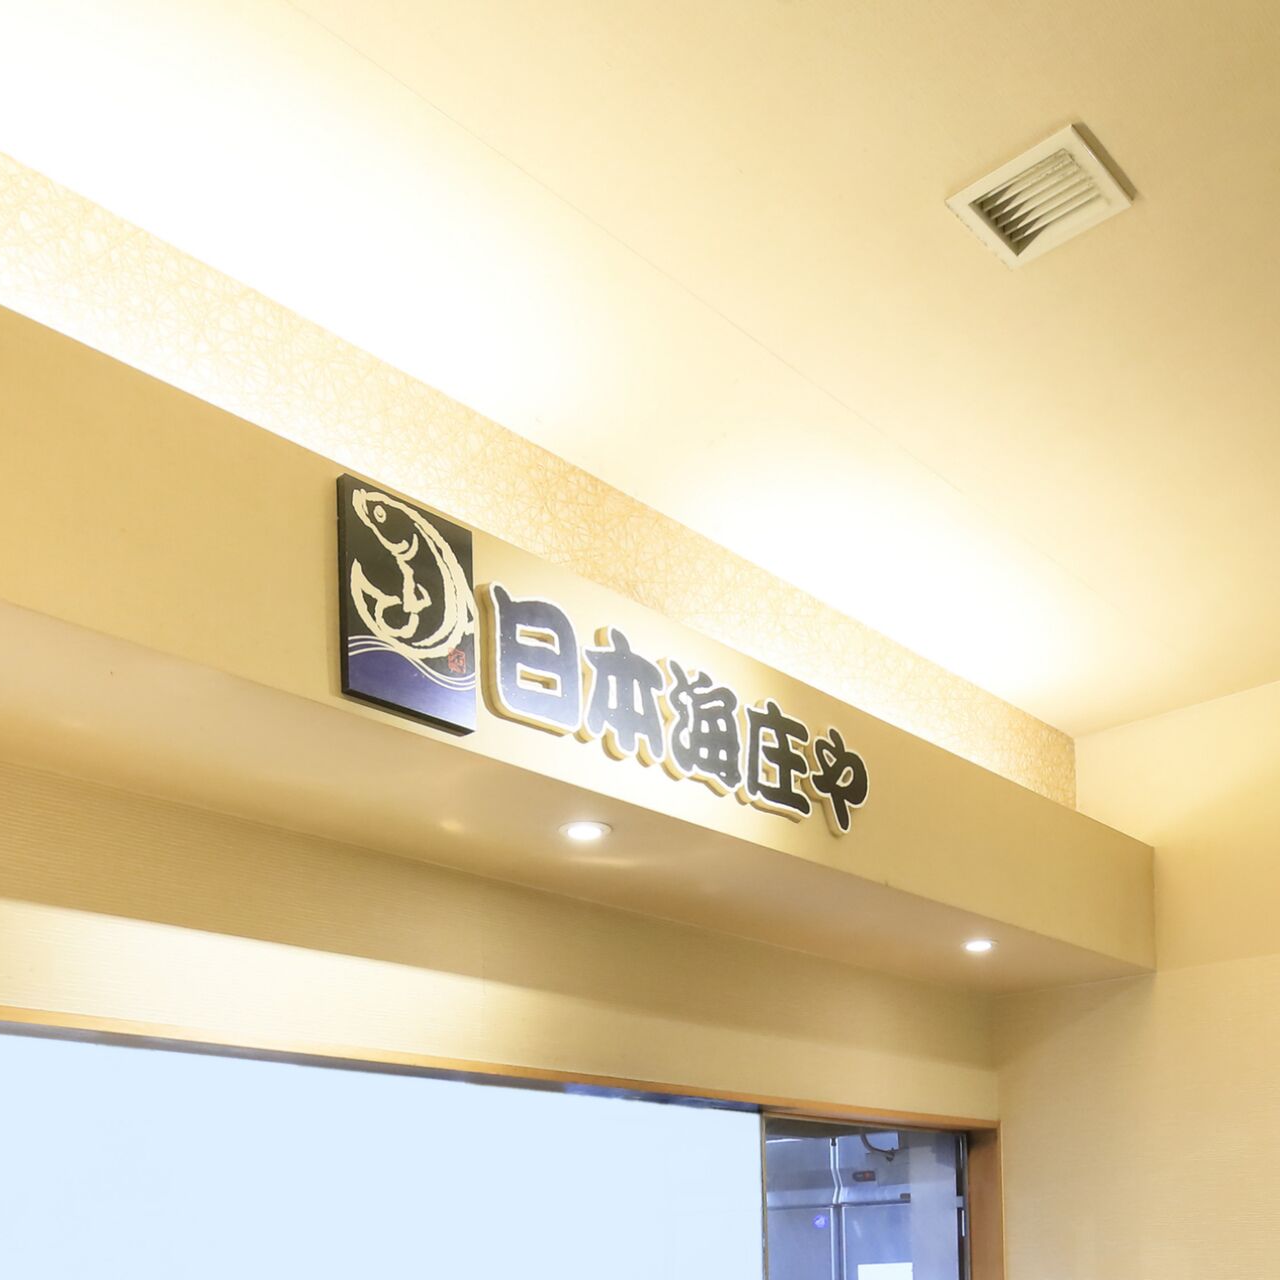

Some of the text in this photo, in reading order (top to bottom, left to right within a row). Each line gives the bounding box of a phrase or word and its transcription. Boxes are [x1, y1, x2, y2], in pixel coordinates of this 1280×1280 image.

[484, 581, 869, 835] 日本海庄や
